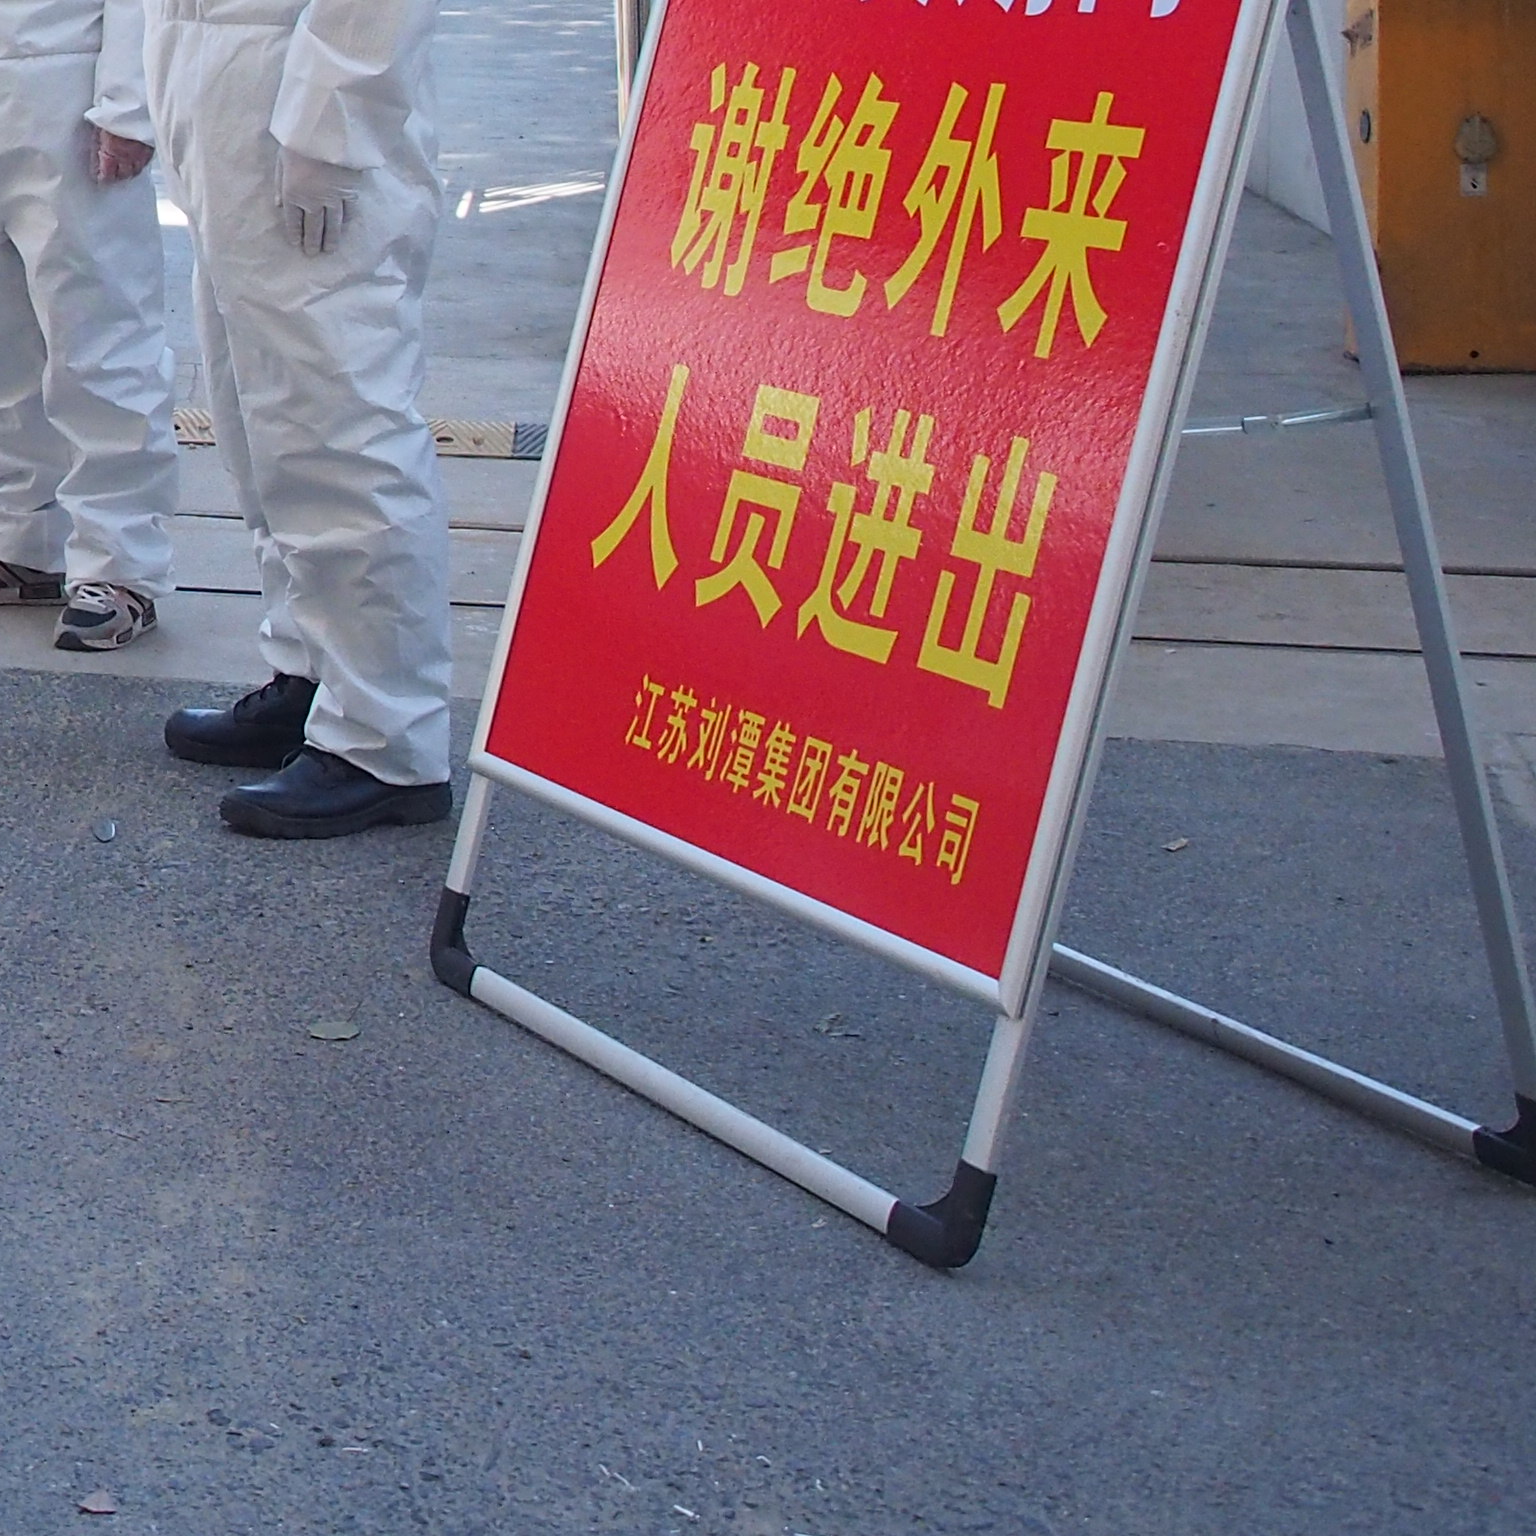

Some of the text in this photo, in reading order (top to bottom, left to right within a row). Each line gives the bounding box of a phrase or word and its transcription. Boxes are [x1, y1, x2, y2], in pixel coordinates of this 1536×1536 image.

[668, 61, 1145, 363] 谢绝外来
[590, 361, 1059, 712] 人员进出
[625, 674, 980, 885] 江苏刘潭集团有限公司
